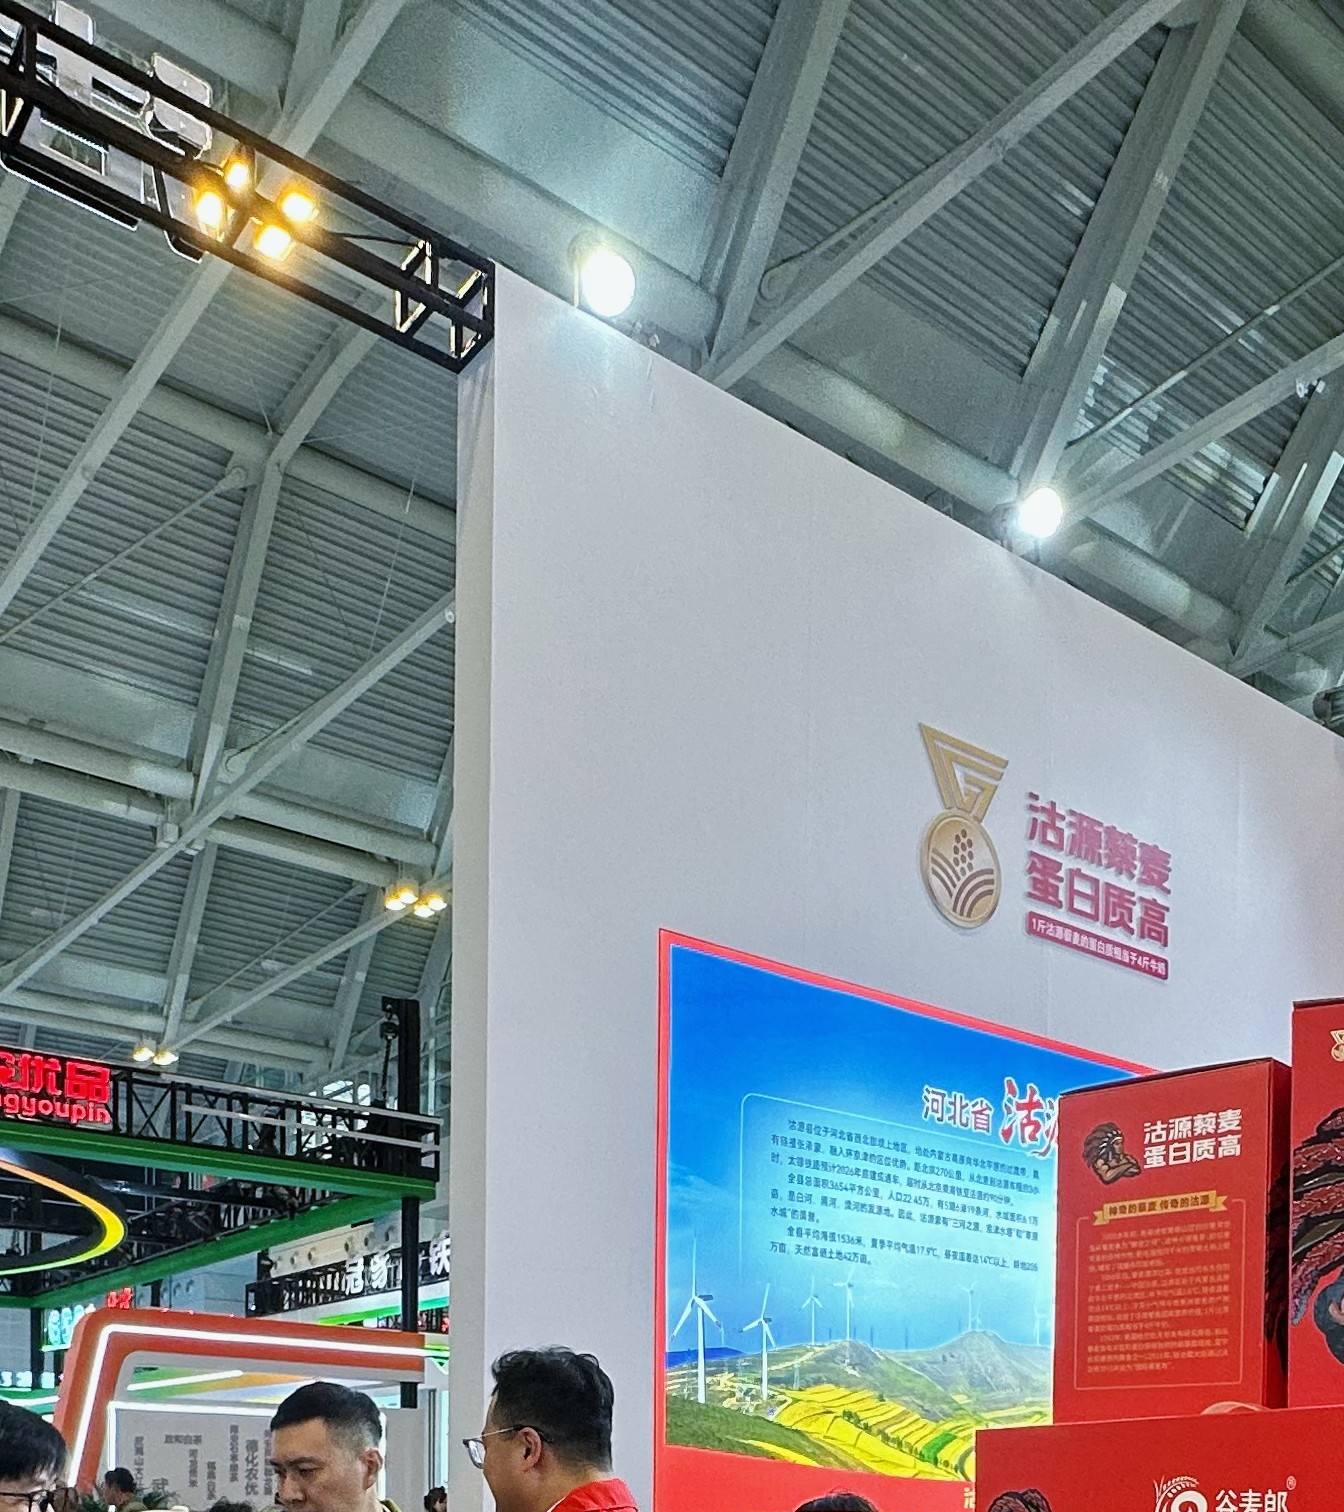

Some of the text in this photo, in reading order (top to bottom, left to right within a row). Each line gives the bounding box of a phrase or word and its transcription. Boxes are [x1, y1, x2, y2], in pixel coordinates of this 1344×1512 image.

[1026, 851, 1170, 948] 蛋白质高
[922, 1076, 1060, 1158] 河北省 沽
[1144, 1108, 1242, 1144] 沽源藜麦
[1144, 1134, 1241, 1170] 蛋白质高
